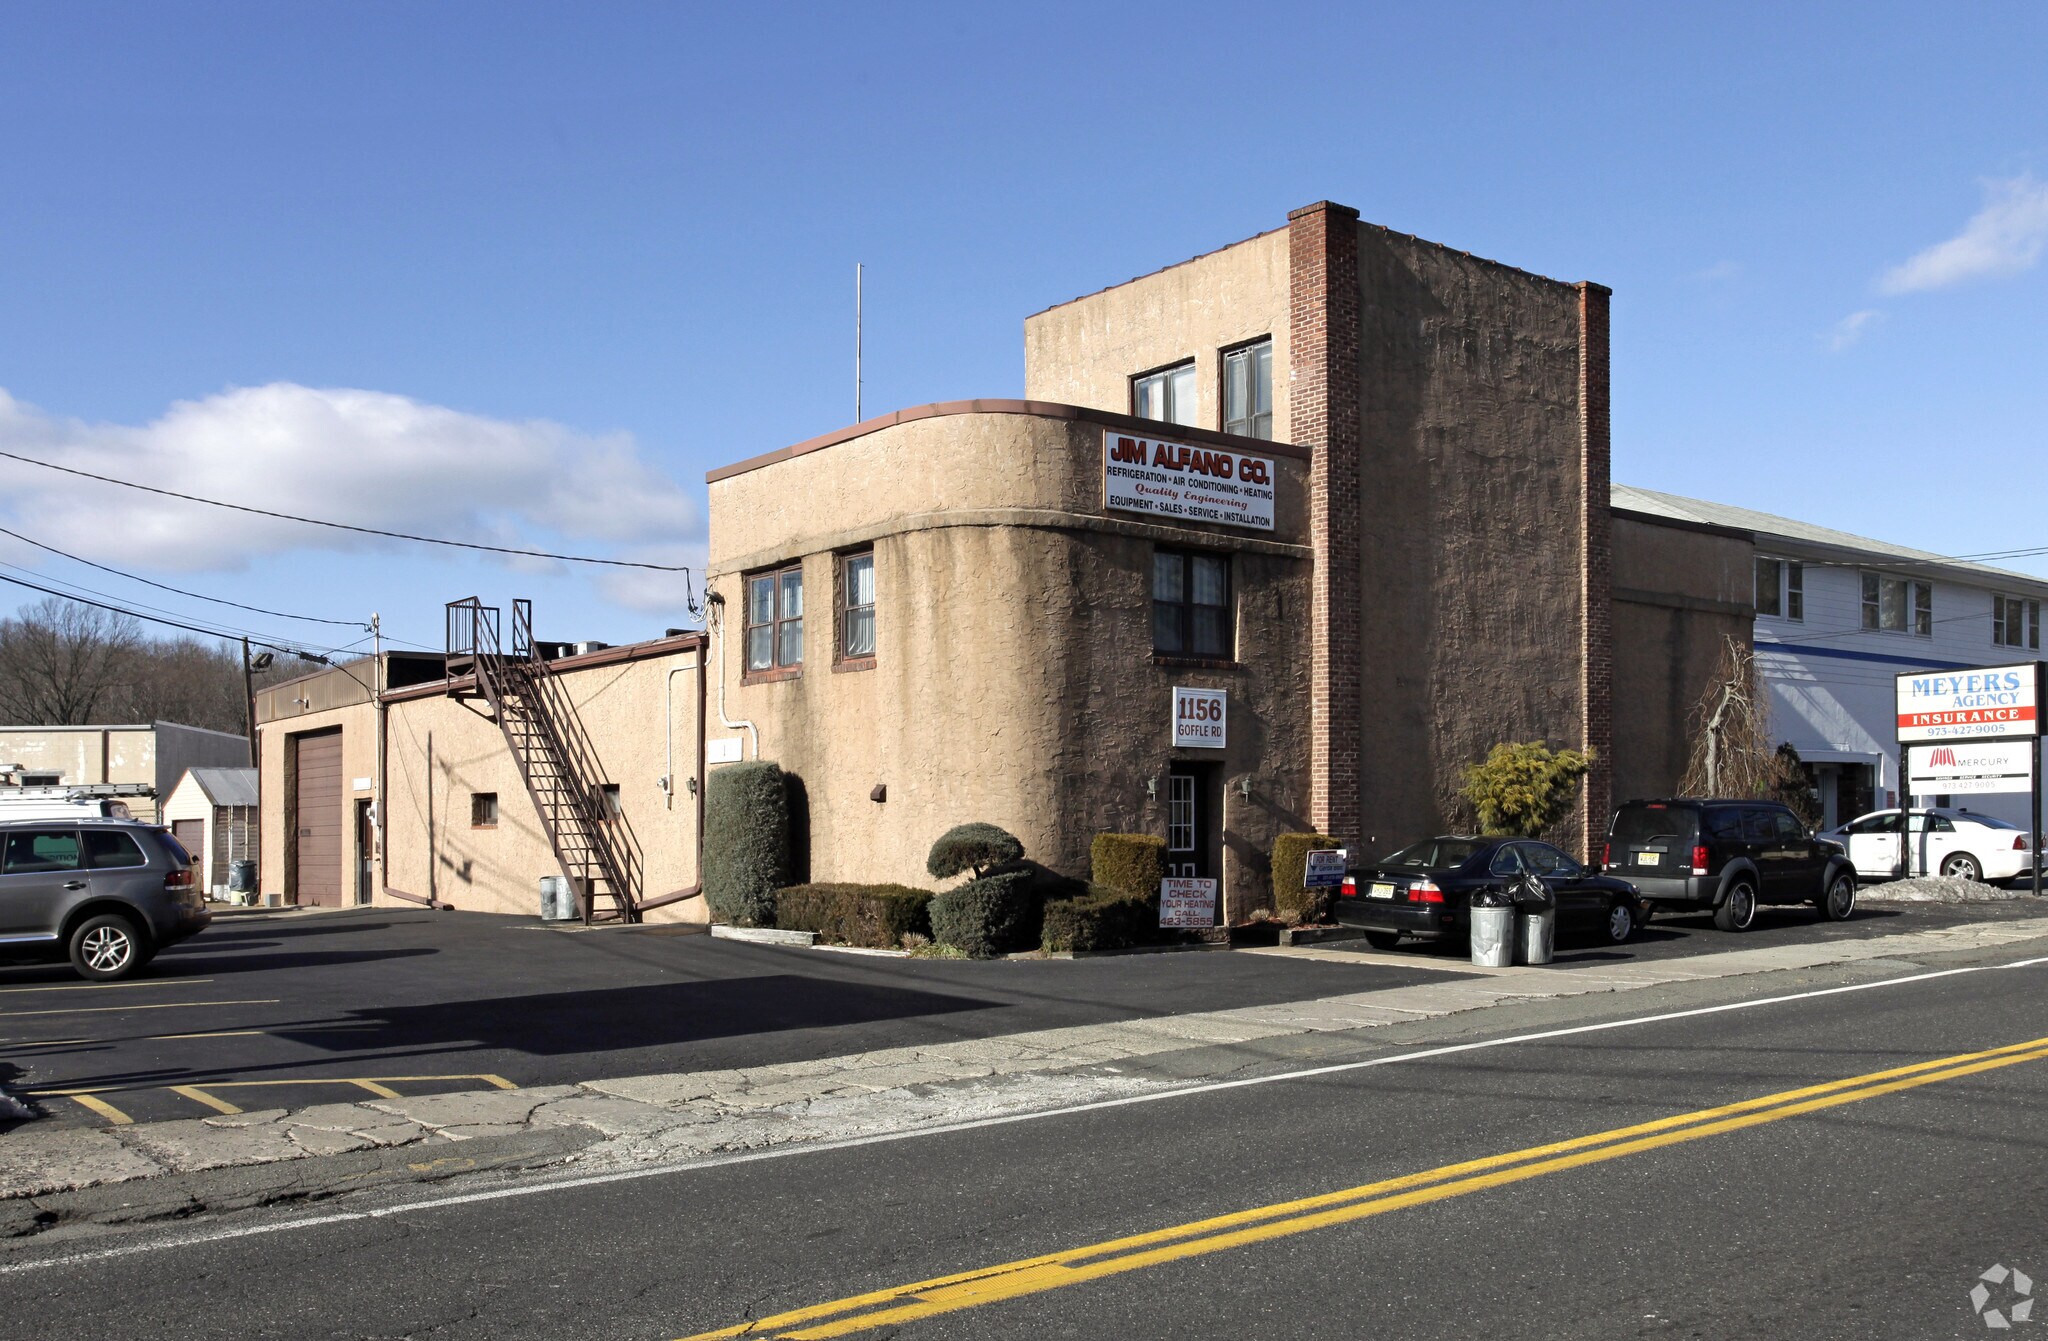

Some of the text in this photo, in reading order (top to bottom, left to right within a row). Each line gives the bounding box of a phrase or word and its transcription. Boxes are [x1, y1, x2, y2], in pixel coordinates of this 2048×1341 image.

[1111, 437, 1270, 485] JIM ALFANO CO.
[1107, 465, 1273, 500] REFRIGERATION AIR CONDITIONING HEATING
[1135, 483, 1248, 511] Quality Engineering
[1110, 495, 1270, 526] EQUIPMENT SALES SERVICE INSTALLATION
[1912, 671, 2020, 698] MEYERS
[1952, 692, 2019, 708] AGENCY
[1178, 697, 1222, 722] 1156
[1913, 709, 2019, 725] INSURANCE
[1178, 724, 1209, 737] GOFFLE
[1928, 724, 2006, 737] 973-427-9005
[1958, 757, 2009, 767] MERCURY
[1942, 781, 1996, 790] 973 427 9005
[1316, 855, 1338, 863] FOR RENT
[1167, 880, 1212, 889] TIME TO
[1169, 890, 1207, 899] CHECK
[1161, 899, 1215, 909] YOUR HEATING
[1160, 917, 1213, 926] 423-5855
